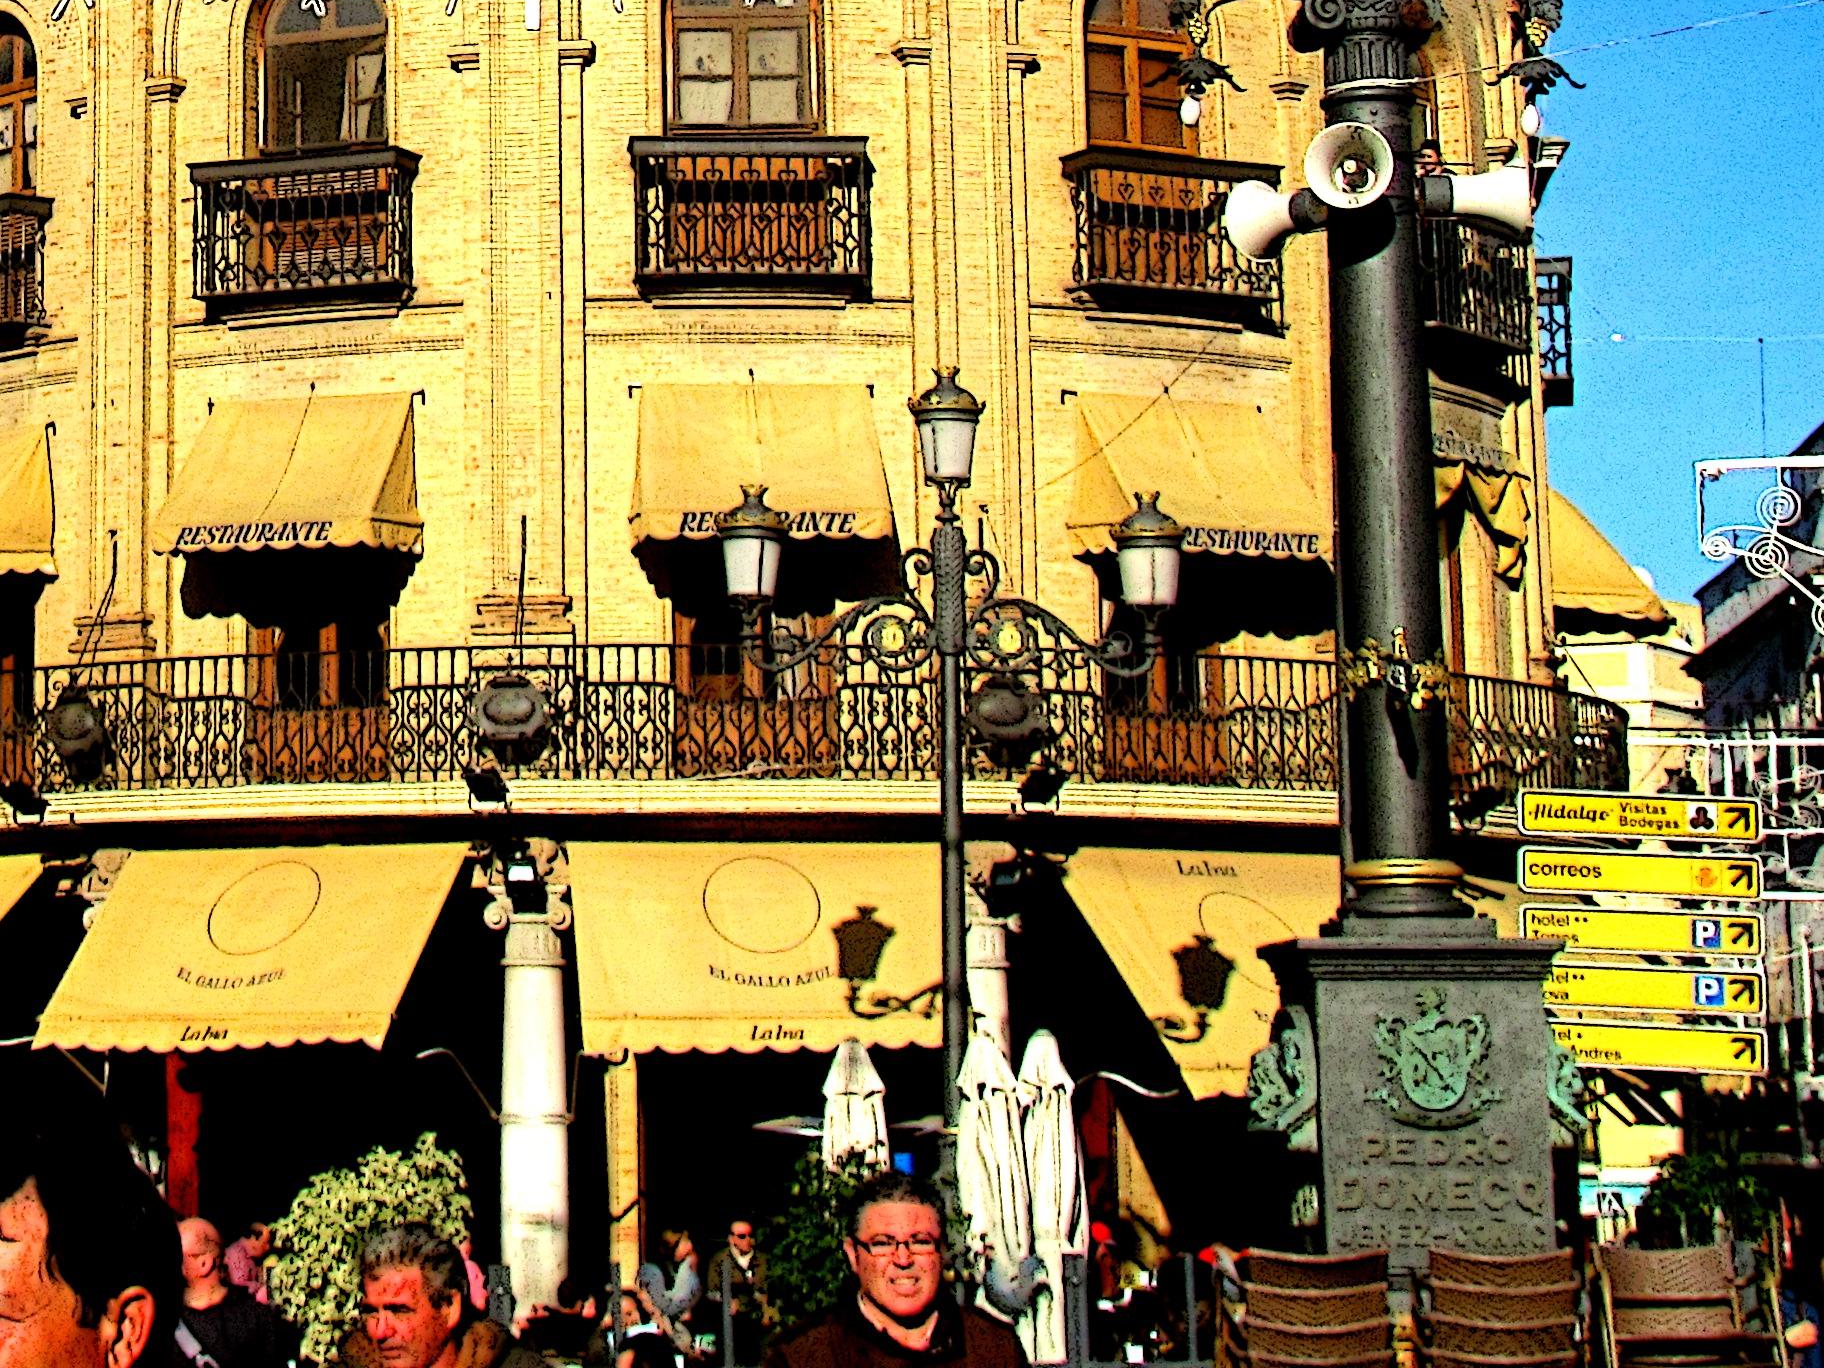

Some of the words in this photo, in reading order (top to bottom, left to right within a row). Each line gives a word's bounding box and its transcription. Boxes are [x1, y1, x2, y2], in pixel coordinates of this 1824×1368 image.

[175, 521, 334, 546] RESTAURANTE
[1528, 802, 1610, 823] Hidalgo
[1618, 801, 1667, 815] Visitas
[1618, 815, 1681, 831] Bodegas
[1529, 862, 1603, 879] correos
[1531, 913, 1570, 927] hotel
[734, 972, 791, 988] GALLO
[1358, 1133, 1514, 1167] PEDRO
[1335, 1177, 1546, 1217] DOMECQ
